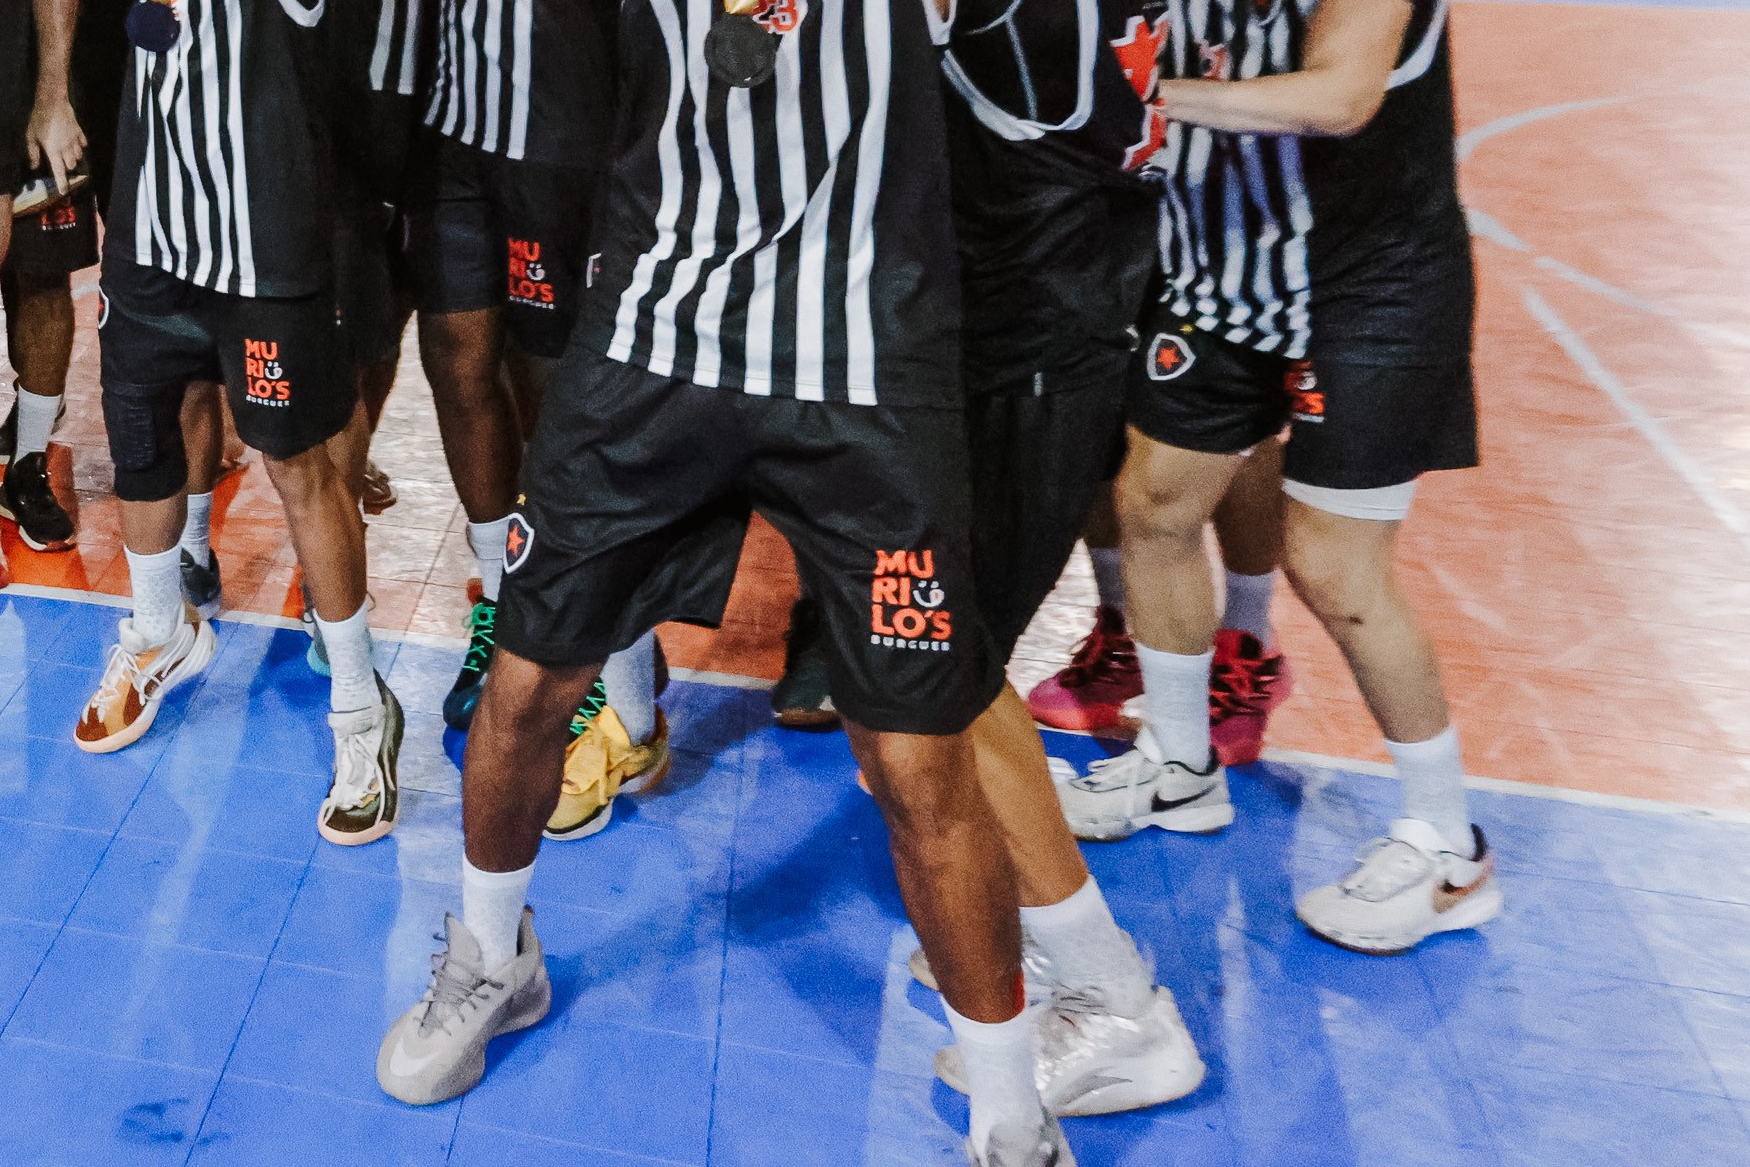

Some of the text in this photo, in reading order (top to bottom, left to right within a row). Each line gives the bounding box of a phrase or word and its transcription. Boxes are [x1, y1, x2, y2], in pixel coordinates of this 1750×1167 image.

[244, 338, 278, 361] MU
[246, 356, 265, 379] RI
[874, 549, 935, 579] MU
[871, 576, 911, 607] RI
